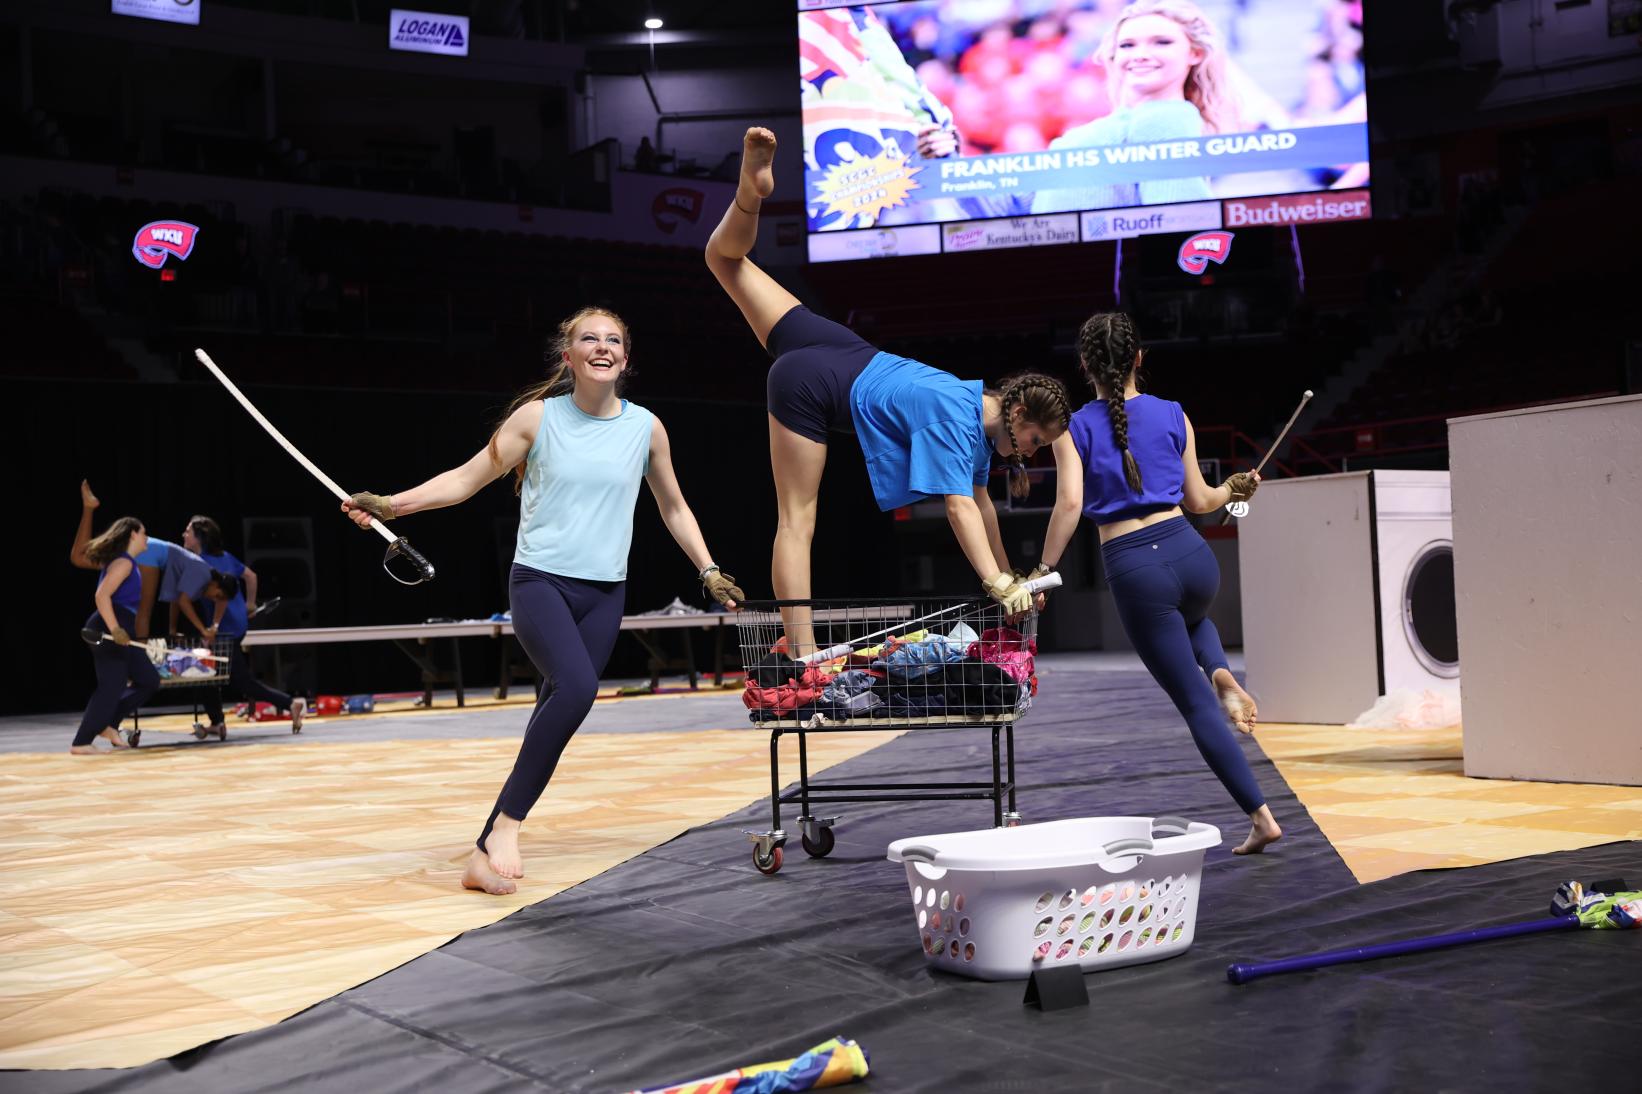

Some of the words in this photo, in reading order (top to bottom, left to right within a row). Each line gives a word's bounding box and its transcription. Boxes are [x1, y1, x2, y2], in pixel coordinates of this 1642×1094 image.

[398, 19, 449, 37] LOGAN
[394, 34, 442, 45] ALUMINUM
[941, 152, 1061, 178] FRANKLIN
[1067, 149, 1100, 168] HS
[1106, 140, 1200, 164] WINTER
[1206, 132, 1297, 156] GUARD
[941, 179, 997, 193] Franklin,
[999, 176, 1018, 188] TN
[1226, 198, 1367, 227] Budweiser
[1010, 219, 1026, 230] We
[1113, 214, 1164, 232] Ruoff
[151, 229, 183, 246] WKU
[986, 232, 1042, 246] Kentucky's
[1046, 229, 1076, 243] Dairy
[1192, 238, 1221, 252] WKU
